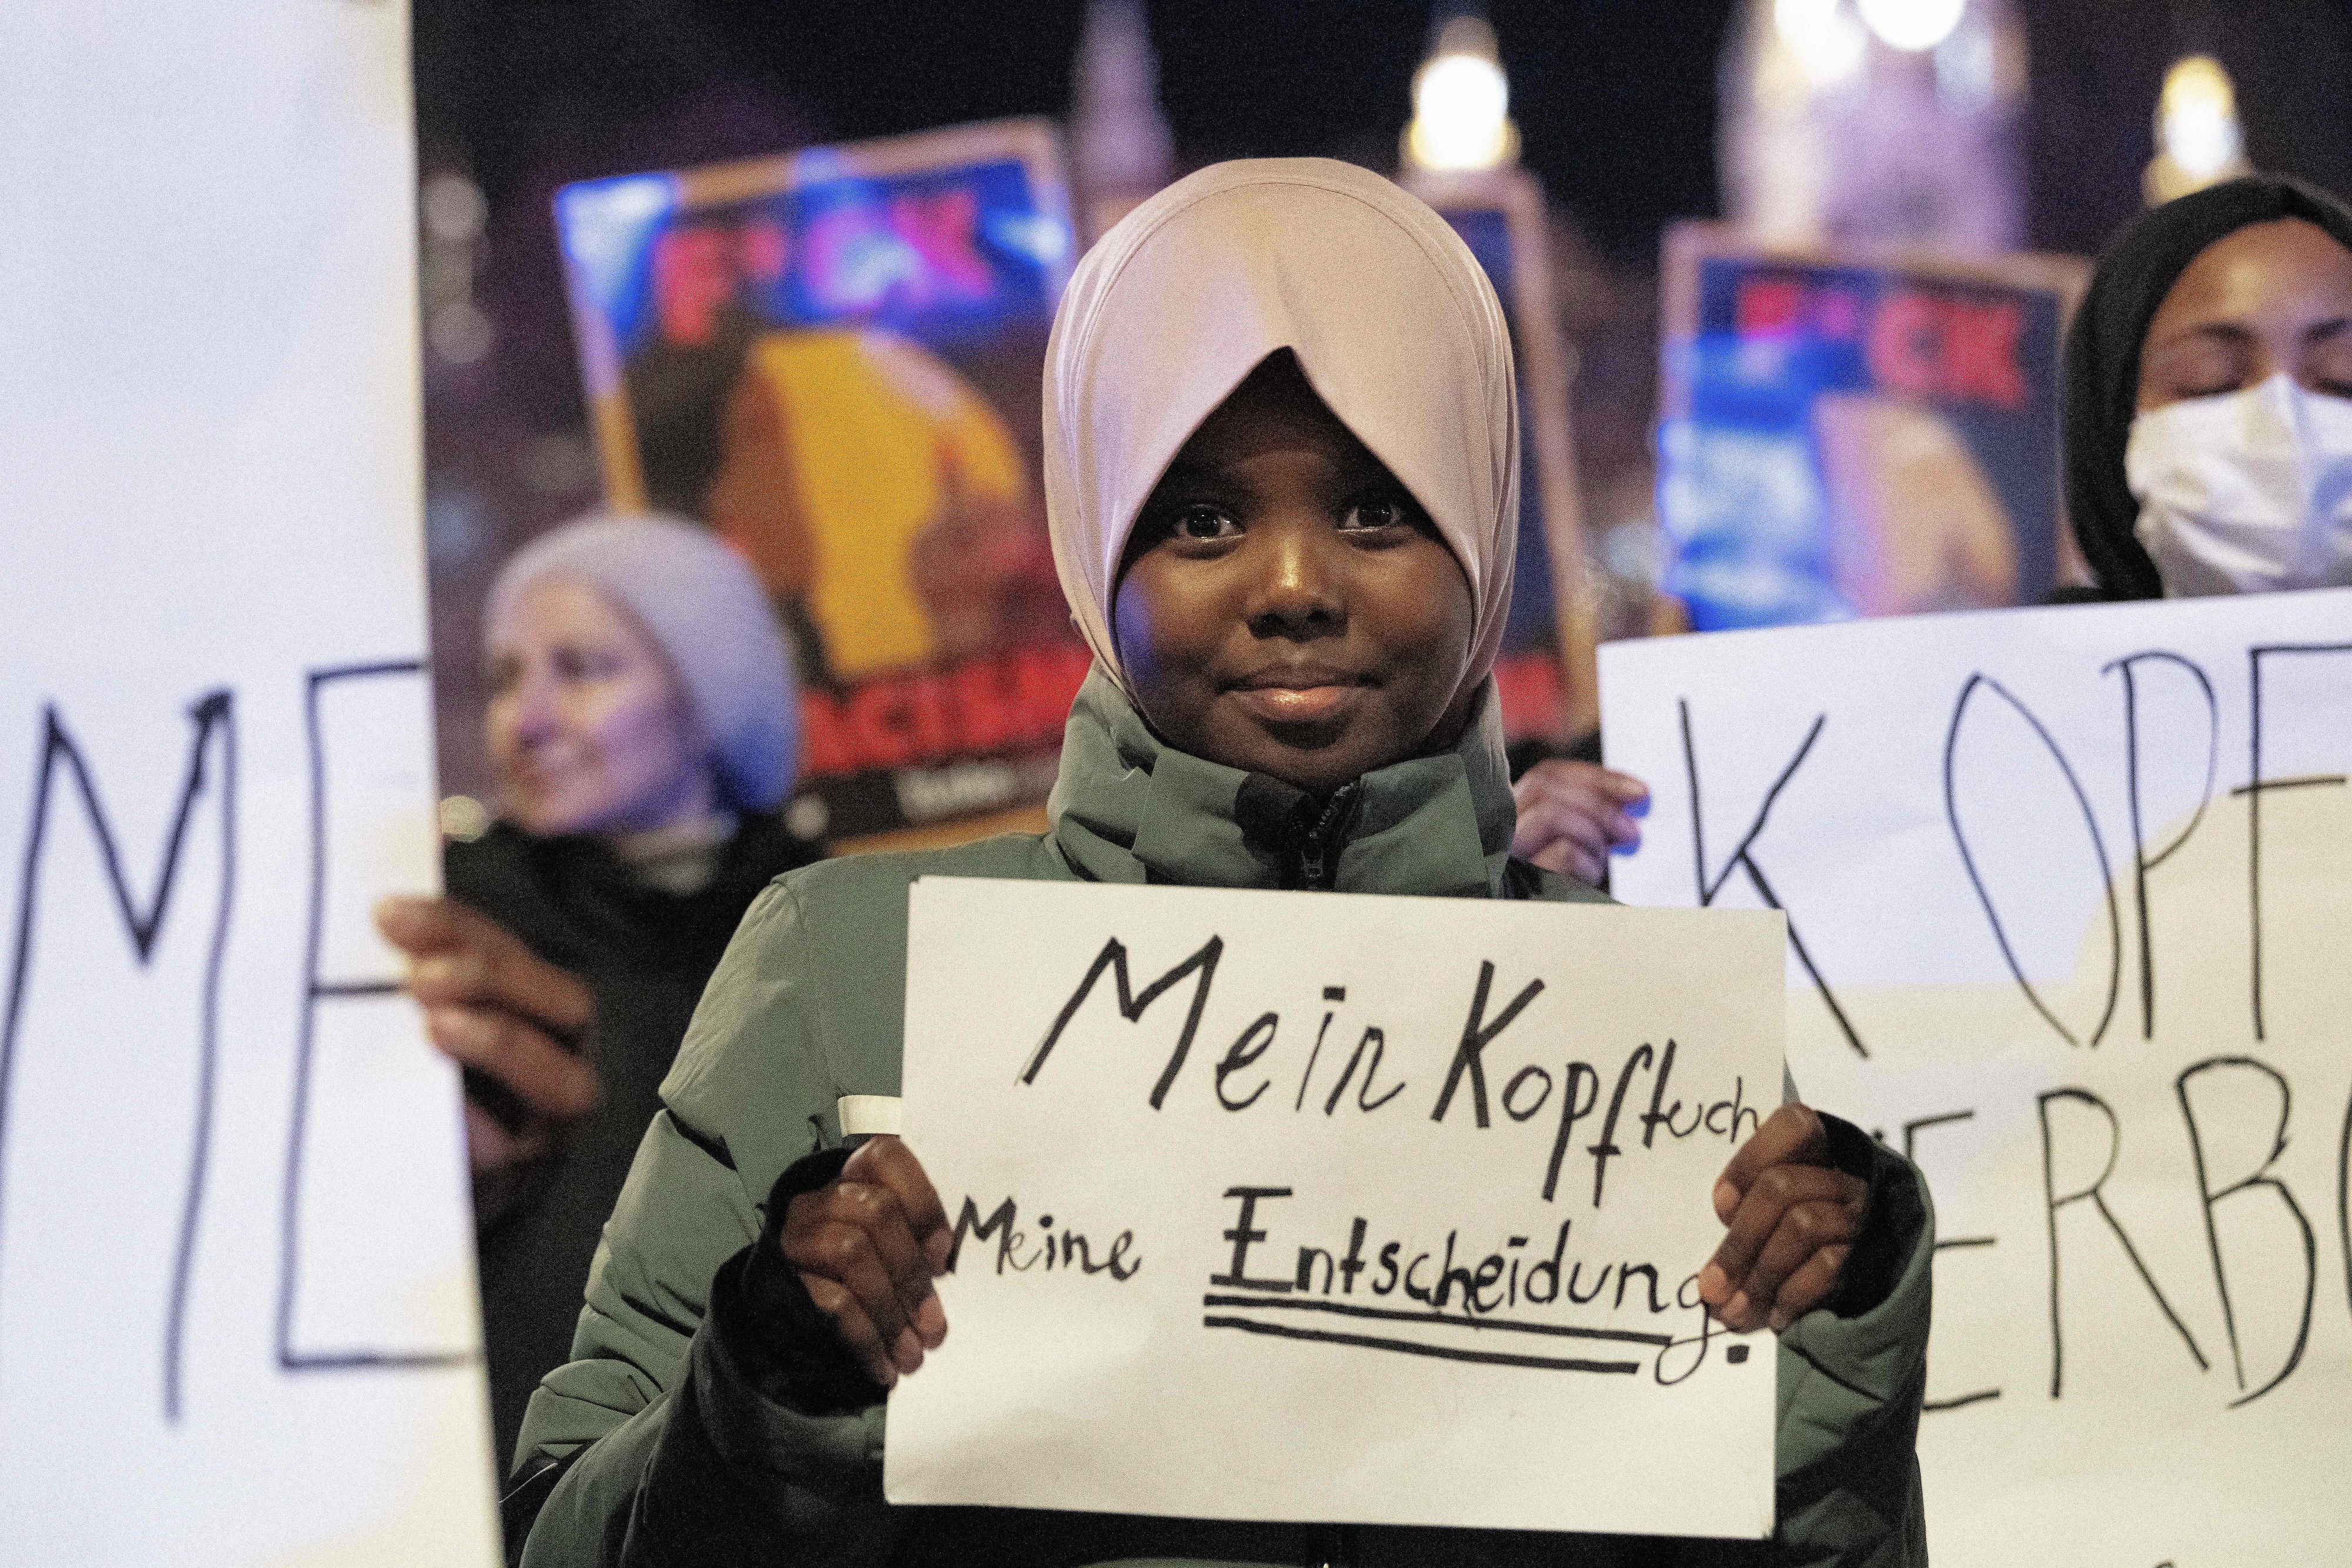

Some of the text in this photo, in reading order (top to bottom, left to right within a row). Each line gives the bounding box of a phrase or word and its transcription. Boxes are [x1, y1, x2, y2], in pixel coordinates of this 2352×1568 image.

[1017, 934, 1759, 1208] Mein Kopftuch
[946, 1186, 1750, 1386] Meine Entscheidung.
[1872, 1055, 2352, 1410] ERB
